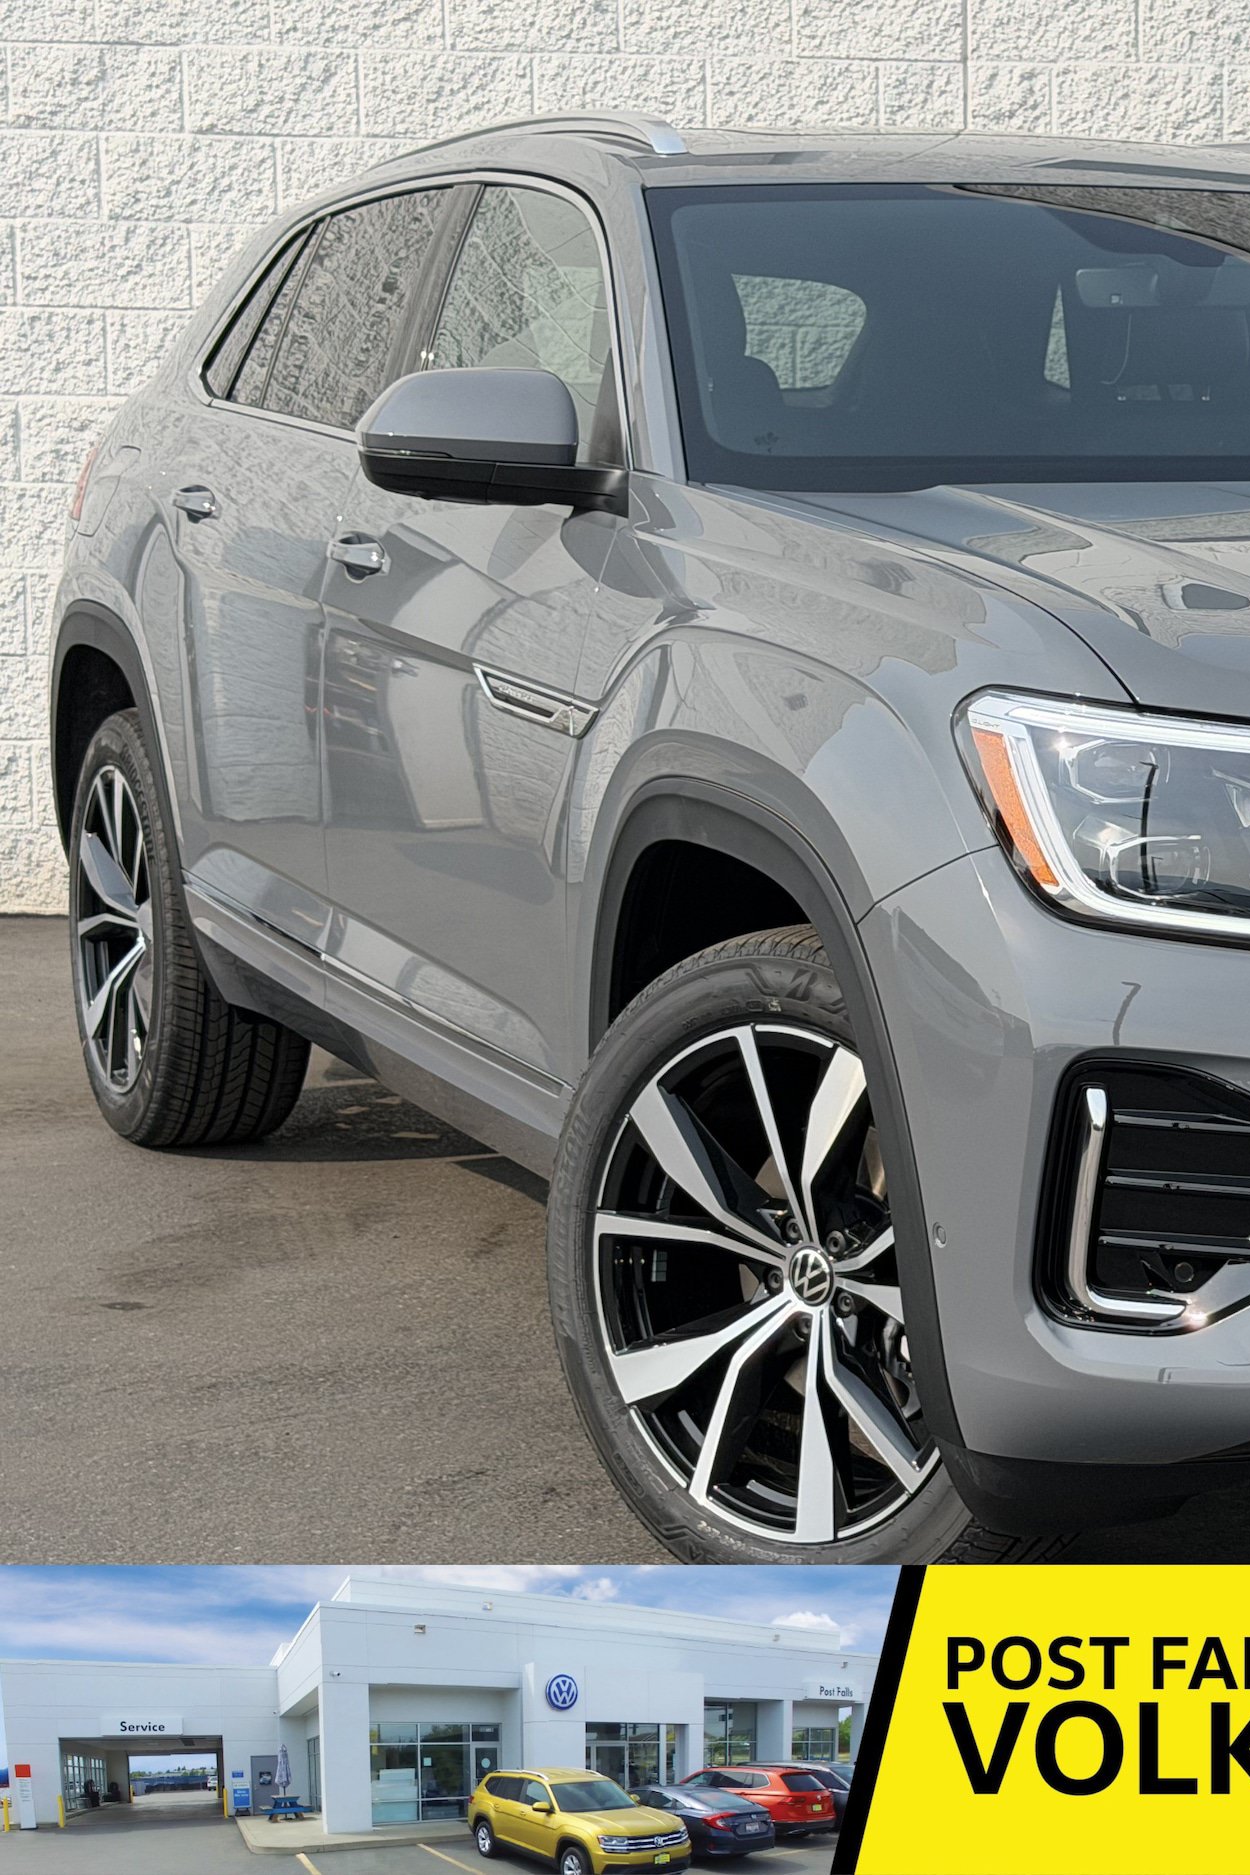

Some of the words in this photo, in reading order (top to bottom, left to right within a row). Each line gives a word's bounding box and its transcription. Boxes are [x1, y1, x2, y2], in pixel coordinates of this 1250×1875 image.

[546, 1674, 578, 1710] VW
[819, 1685, 835, 1697] Post
[836, 1686, 854, 1698] Falls
[120, 1720, 166, 1732] Service
